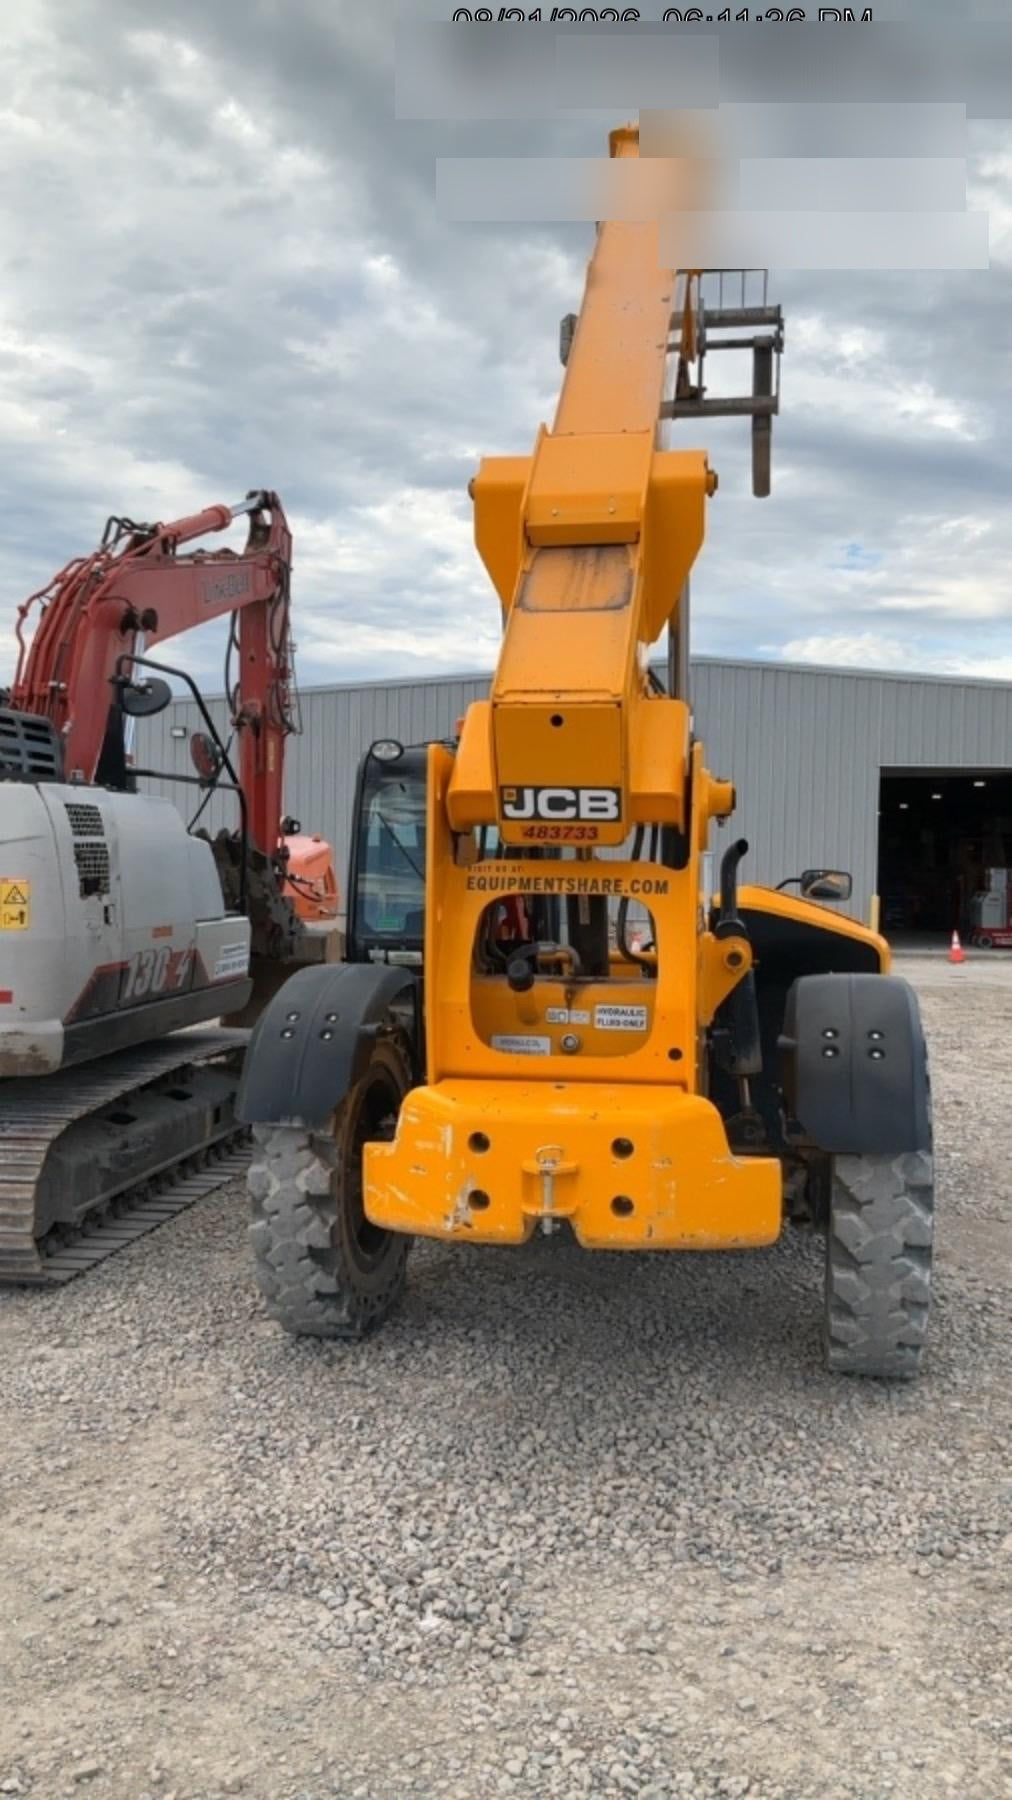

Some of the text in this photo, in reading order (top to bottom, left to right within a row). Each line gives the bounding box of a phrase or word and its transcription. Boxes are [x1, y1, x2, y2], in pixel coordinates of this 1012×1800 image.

[503, 788, 619, 819] JCB
[522, 826, 599, 840] 483733
[466, 876, 669, 894] EQUIPMENTSHARE.COM
